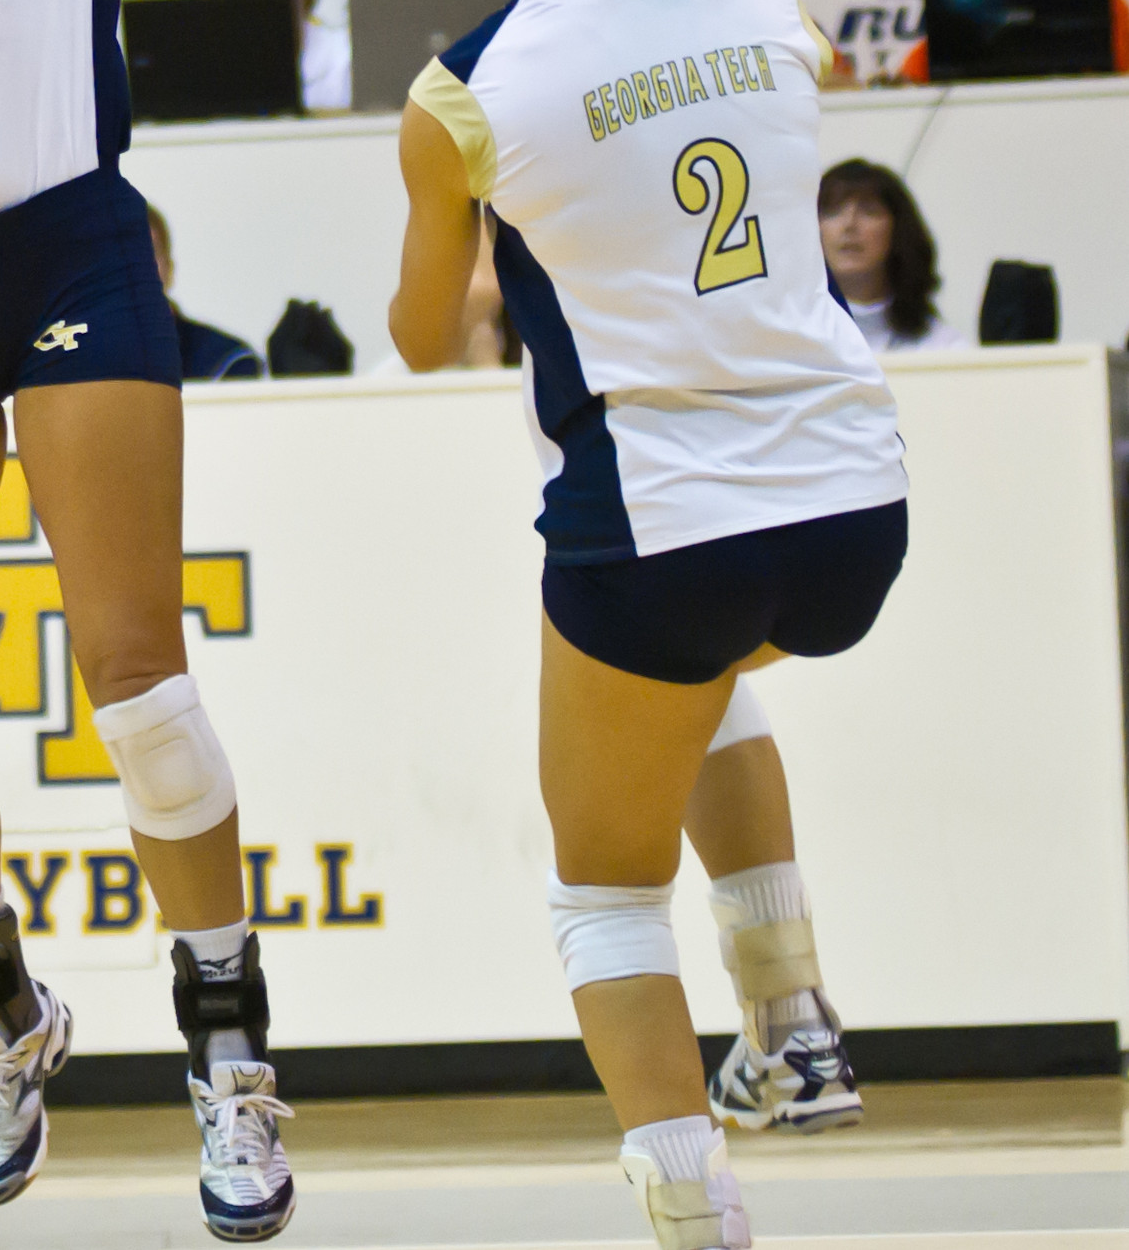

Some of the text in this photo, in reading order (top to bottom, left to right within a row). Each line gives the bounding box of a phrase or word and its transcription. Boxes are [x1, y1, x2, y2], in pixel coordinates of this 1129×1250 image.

[583, 56, 710, 142] GEORGIA
[703, 45, 777, 97] TECH
[672, 137, 768, 297] 2
